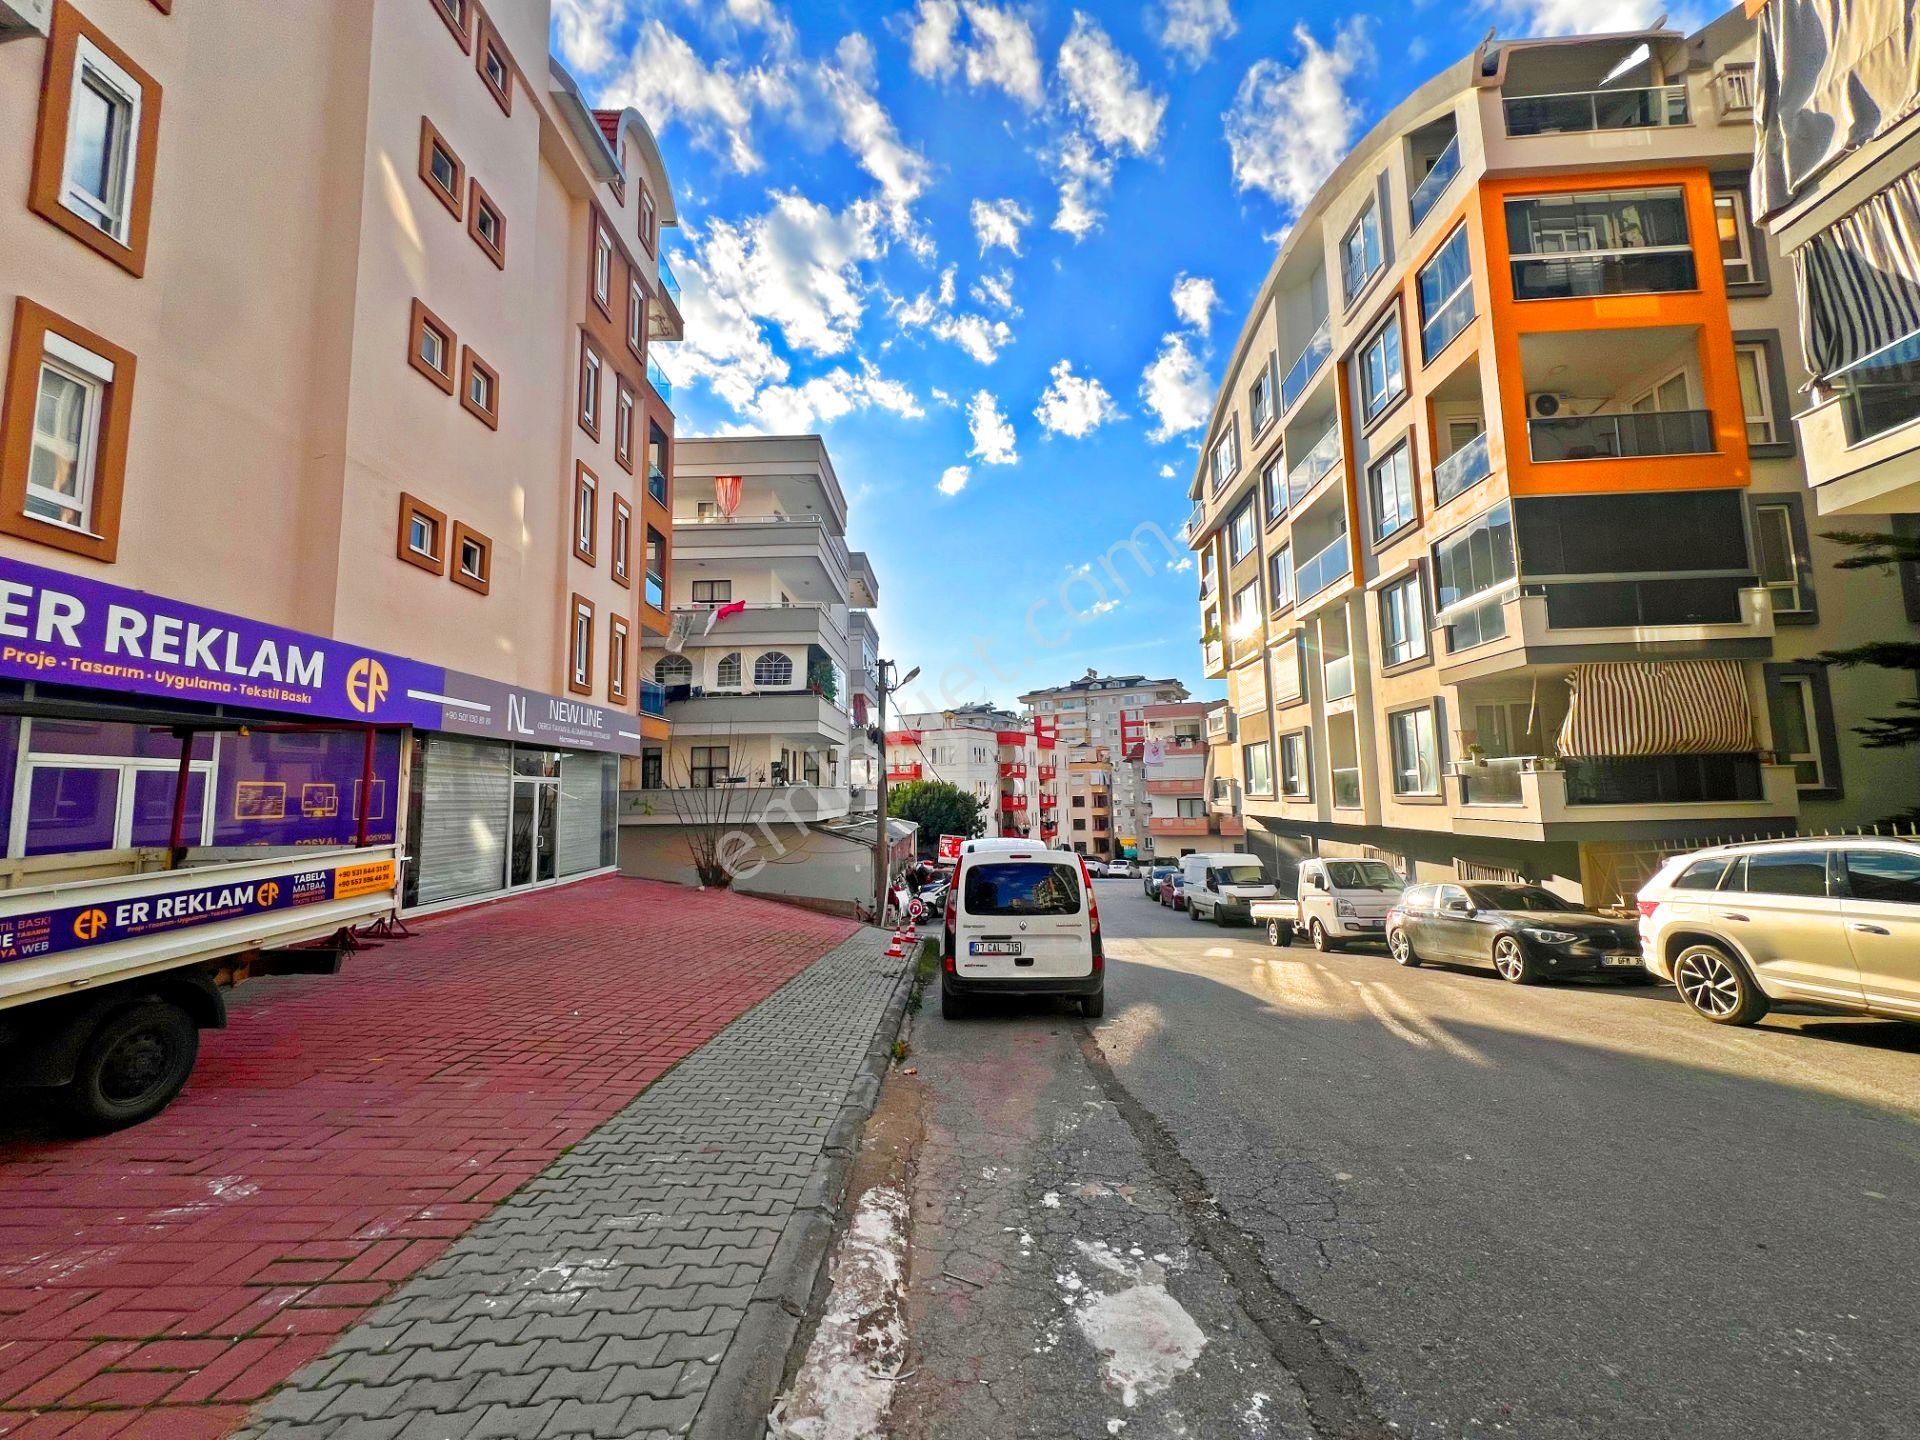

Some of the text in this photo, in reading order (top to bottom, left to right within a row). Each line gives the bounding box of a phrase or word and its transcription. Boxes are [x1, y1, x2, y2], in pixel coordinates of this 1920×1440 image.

[0, 579, 325, 688] ER REKLAM
[3, 646, 312, 704] Proje Tasarım Uygulama Tekstil Baskı
[507, 693, 535, 735] NL
[294, 871, 326, 884] TABELA
[293, 881, 325, 893] MATBAA
[115, 885, 254, 927] ER REKLAM
[17, 916, 51, 930] BASKI
[22, 941, 49, 954] WEB
[975, 943, 985, 953] 07
[1006, 943, 1020, 953] 715
[1605, 956, 1613, 965] 07
